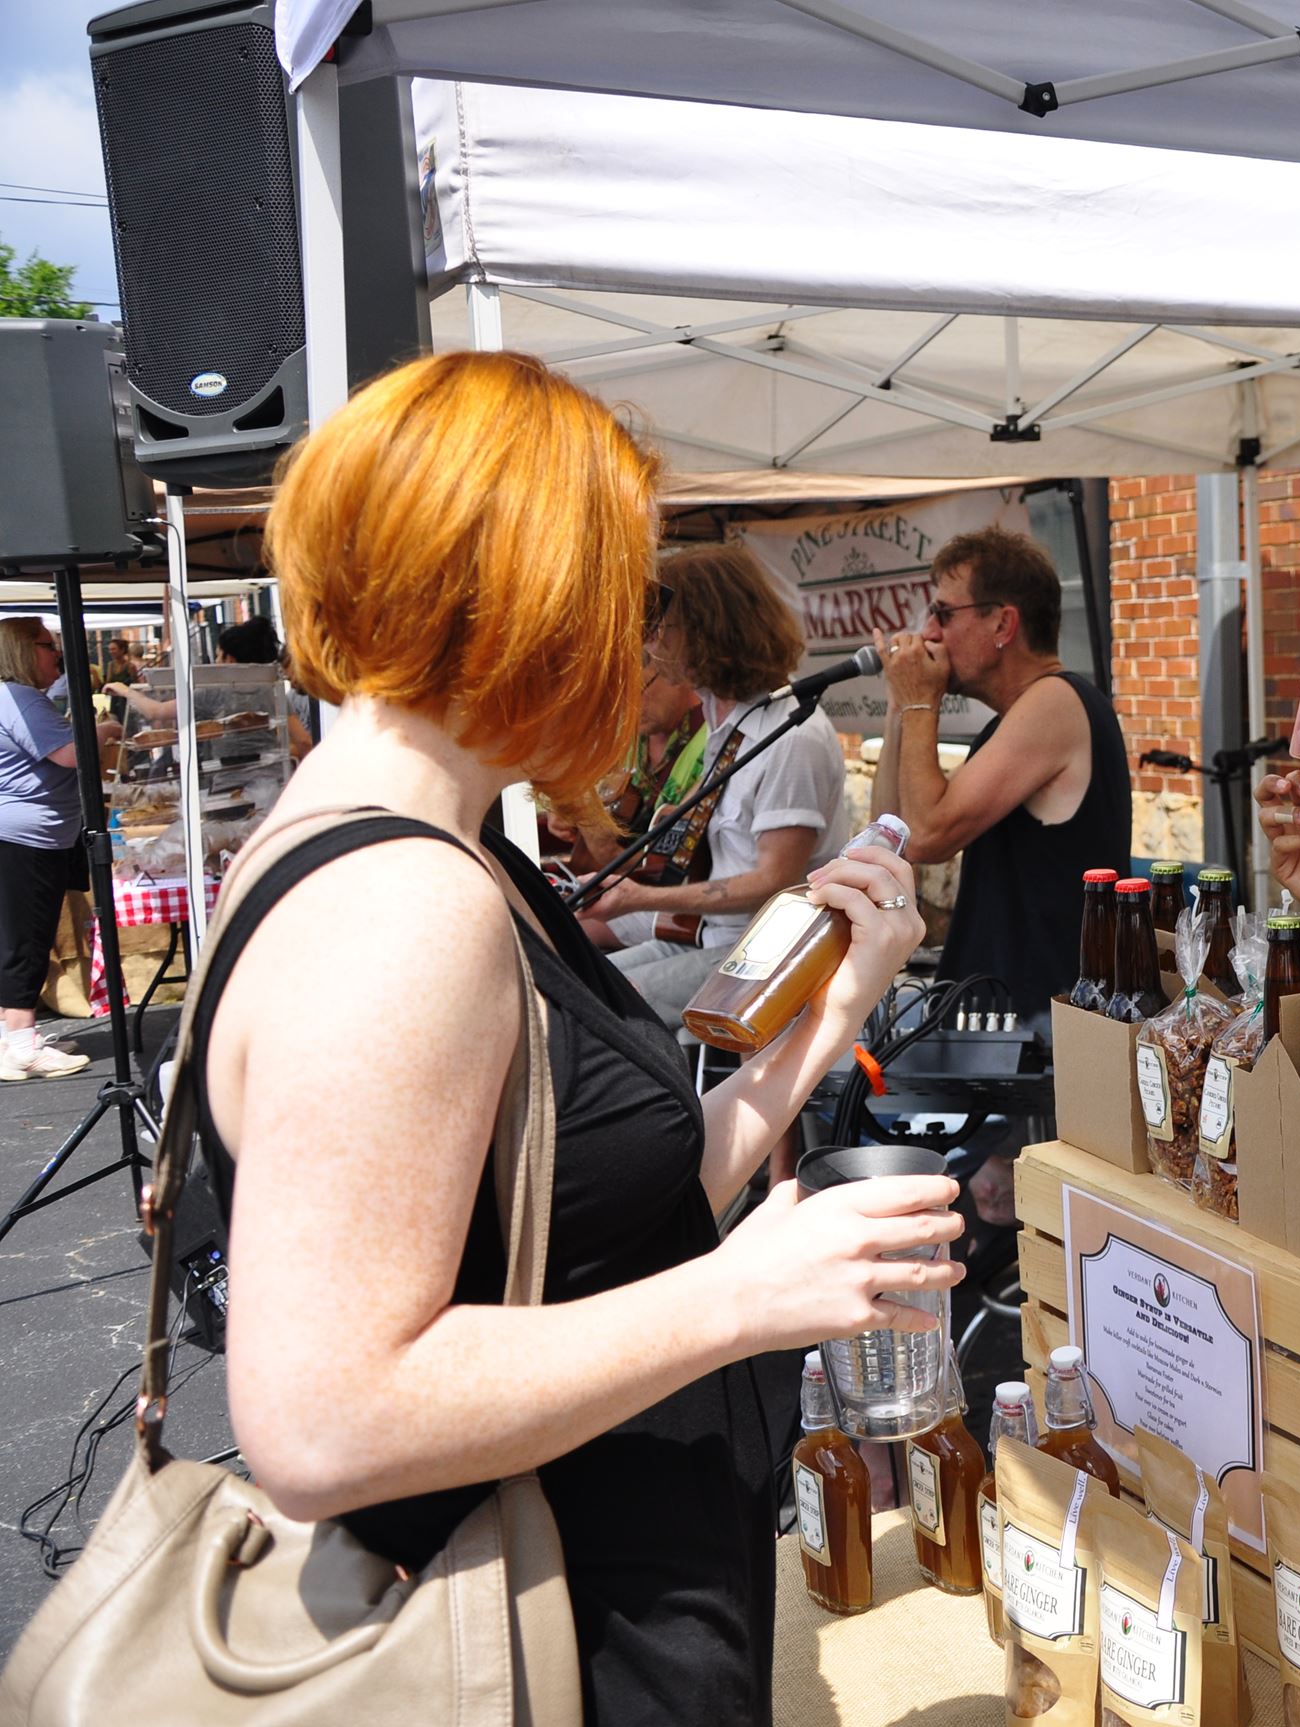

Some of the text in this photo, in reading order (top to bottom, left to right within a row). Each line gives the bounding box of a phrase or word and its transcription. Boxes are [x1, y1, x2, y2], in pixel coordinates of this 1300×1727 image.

[195, 381, 222, 389] SAMSON
[790, 515, 932, 578] PINE STREET
[801, 581, 934, 640] MARKET
[1128, 1269, 1198, 1310] VERDANT KITCHEN
[1069, 1502, 1079, 1524] Live
[1036, 1561, 1064, 1581] KITCHEN
[1166, 1558, 1179, 1583] Live
[1020, 1582, 1058, 1615] GINGER
[1279, 1608, 1296, 1638] BARE
[1117, 1647, 1156, 1682] GINGER
